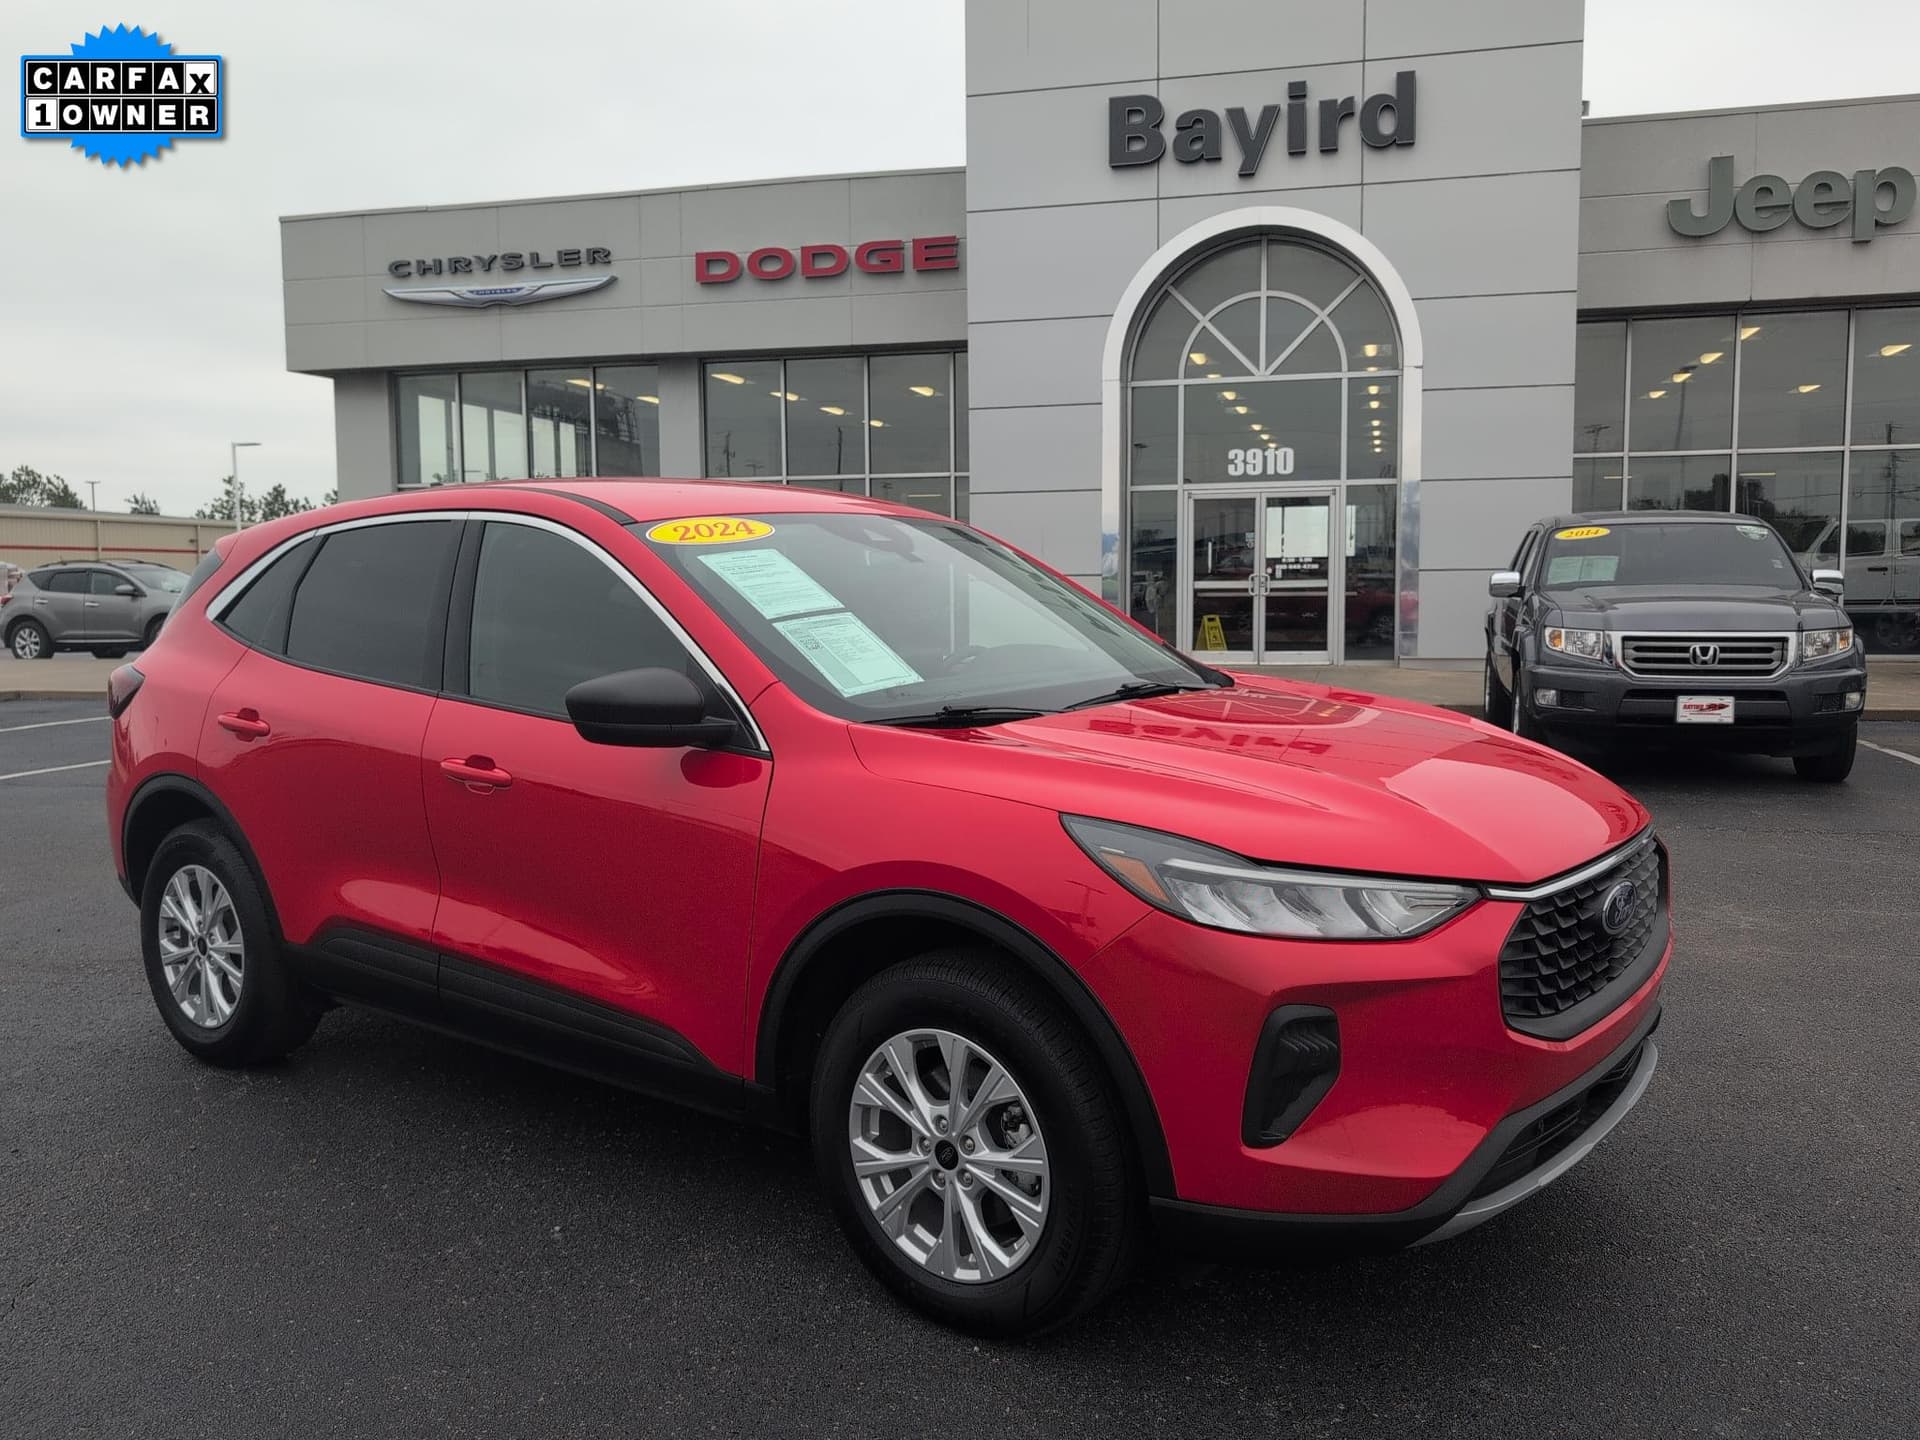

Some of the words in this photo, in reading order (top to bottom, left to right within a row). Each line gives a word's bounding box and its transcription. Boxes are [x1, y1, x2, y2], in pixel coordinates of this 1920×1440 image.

[1108, 70, 1416, 177] Bayird
[1666, 155, 1917, 244] Jeep
[388, 247, 613, 278] CHRYSLER
[695, 235, 960, 284] DODGE
[1227, 447, 1295, 476] 3910
[673, 521, 757, 541] 2024
